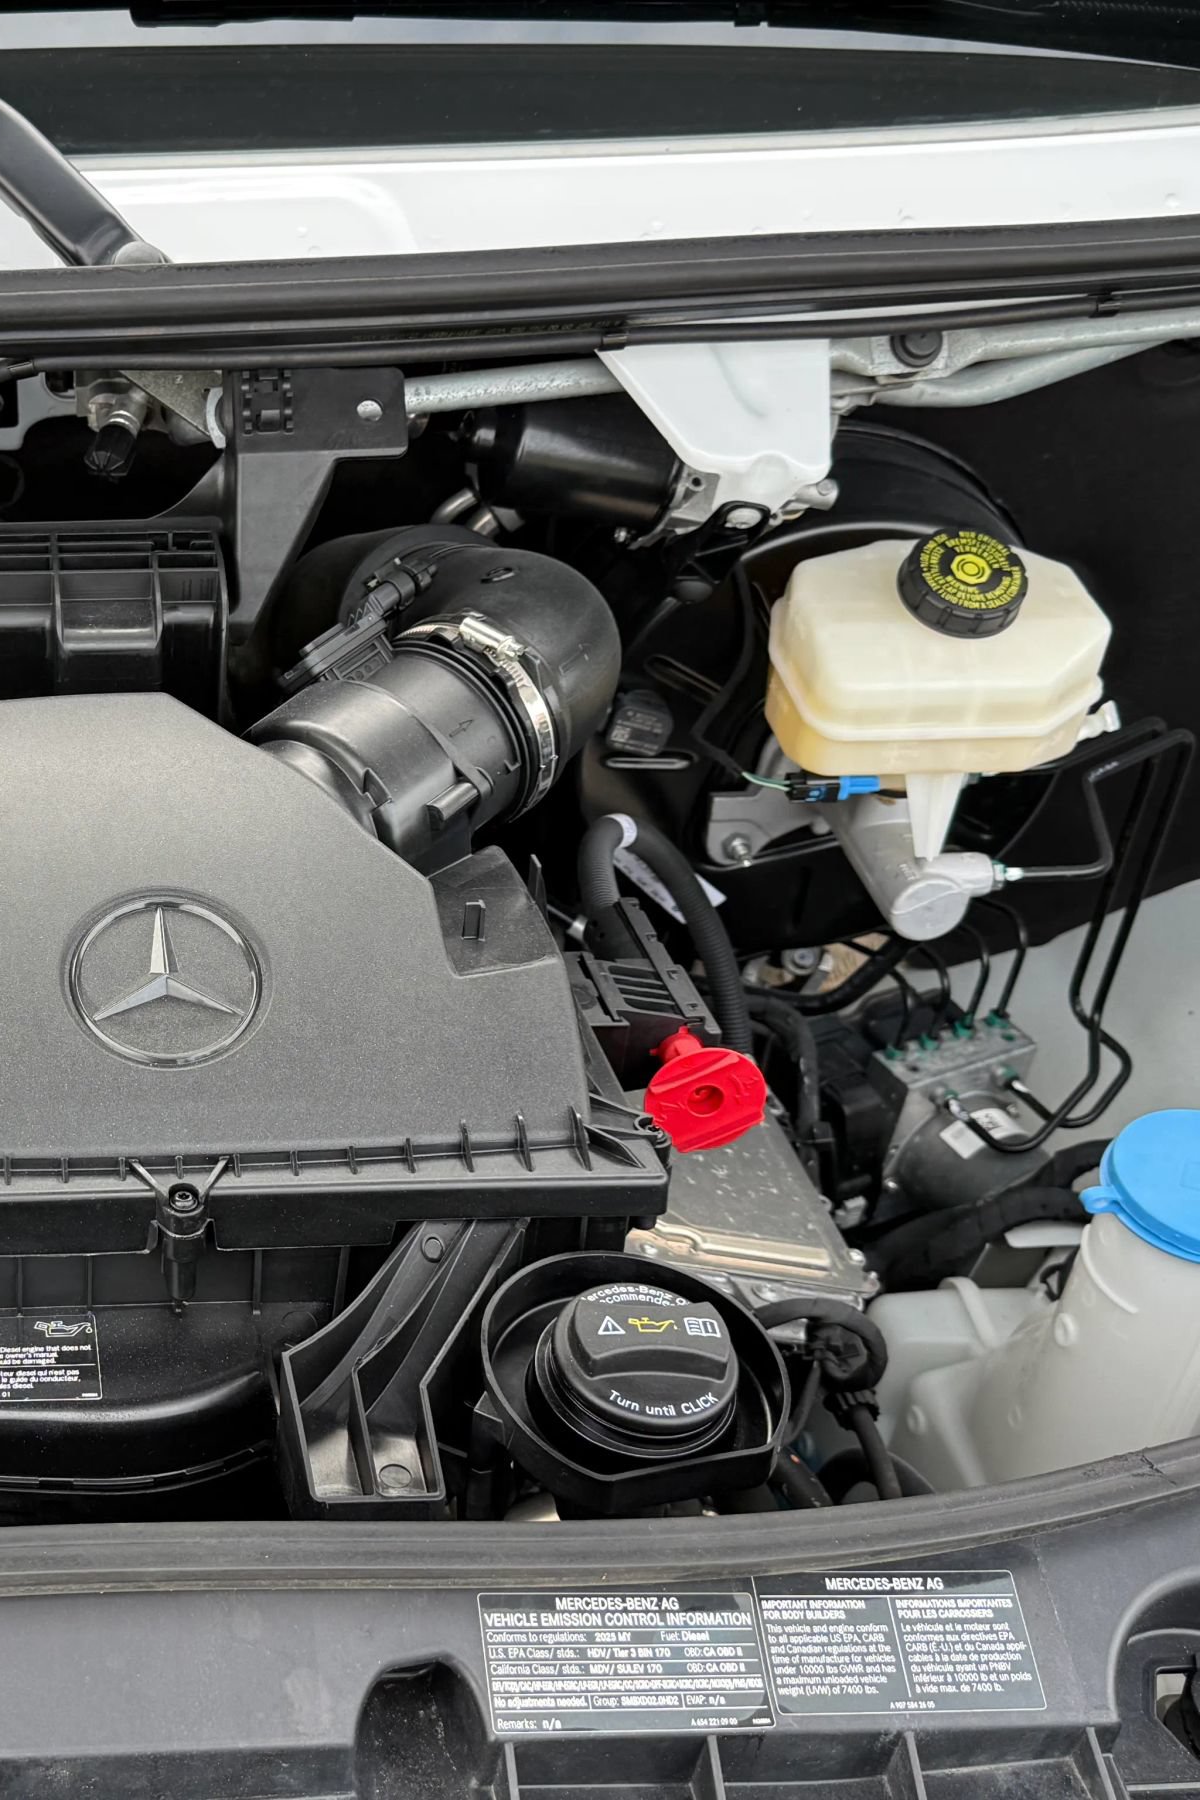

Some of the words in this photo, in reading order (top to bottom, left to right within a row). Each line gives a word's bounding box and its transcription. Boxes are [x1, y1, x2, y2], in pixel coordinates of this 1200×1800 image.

[581, 1285, 673, 1301] ercedes-Benz
[609, 1389, 640, 1412] Turn
[645, 1405, 676, 1416] until
[681, 1392, 719, 1414] CLICK
[825, 1577, 924, 1590] MERCEDES-BENZ
[927, 1577, 944, 1590] AG
[555, 1597, 659, 1610] MERCEDES-BENZ
[661, 1597, 679, 1610] AG
[761, 1600, 808, 1609] IMPORTANT
[809, 1600, 866, 1609] INFORMATION
[895, 1599, 956, 1608] INFORMATIONS
[957, 1599, 1012, 1608] IMPORTANTES
[484, 1613, 538, 1626] VEHICLE
[541, 1613, 601, 1626] EMISSION
[605, 1612, 664, 1626] CONTROL
[666, 1612, 751, 1626] INFORMATION
[763, 1610, 781, 1619] FOR
[782, 1610, 804, 1619] BODY
[805, 1610, 846, 1619] BUILDERS
[897, 1610, 920, 1619] POUR
[922, 1610, 937, 1618] LES
[938, 1609, 994, 1618] CARROSSIERS
[766, 1624, 783, 1633] This
[783, 1624, 811, 1632] vehicle
[813, 1623, 827, 1632] and
[829, 1624, 854, 1634] engine
[856, 1623, 888, 1632] conform
[487, 1632, 527, 1642] Conforms
[529, 1632, 537, 1642] to
[539, 1632, 587, 1644] regulations:
[618, 1632, 631, 1642] MY
[681, 1631, 709, 1641] Diesel
[830, 1633, 842, 1642] US
[862, 1633, 885, 1641] CARB
[488, 1648, 506, 1658] U.S.
[508, 1648, 526, 1658] EPA
[614, 1648, 629, 1658] Tier
[630, 1648, 637, 1658] 3
[638, 1648, 653, 1658] BIN
[655, 1648, 671, 1658] 170
[703, 1647, 716, 1657] CA
[717, 1647, 735, 1657] OBD
[770, 1645, 785, 1653] and
[786, 1644, 823, 1653] Canadian
[824, 1644, 867, 1654] regulations
[878, 1643, 891, 1652] the
[864, 1654, 896, 1663] vehicles
[491, 1664, 530, 1674] California
[616, 1664, 644, 1674] SULEV
[646, 1664, 662, 1674] 170
[706, 1663, 719, 1672] CA
[720, 1663, 738, 1672] OBD
[774, 1666, 796, 1674] under
[799, 1665, 824, 1674] 10000
[865, 1664, 880, 1673] and
[882, 1664, 896, 1673] has
[860, 1675, 887, 1683] vehicle
[778, 1686, 804, 1696] weight
[832, 1685, 840, 1694] of
[843, 1685, 863, 1694] 7400
[494, 1696, 505, 1707] No
[593, 1696, 619, 1707] Group:
[709, 1695, 726, 1705] n/a
[497, 1719, 537, 1729] Remarks:
[542, 1719, 561, 1729] n/a
